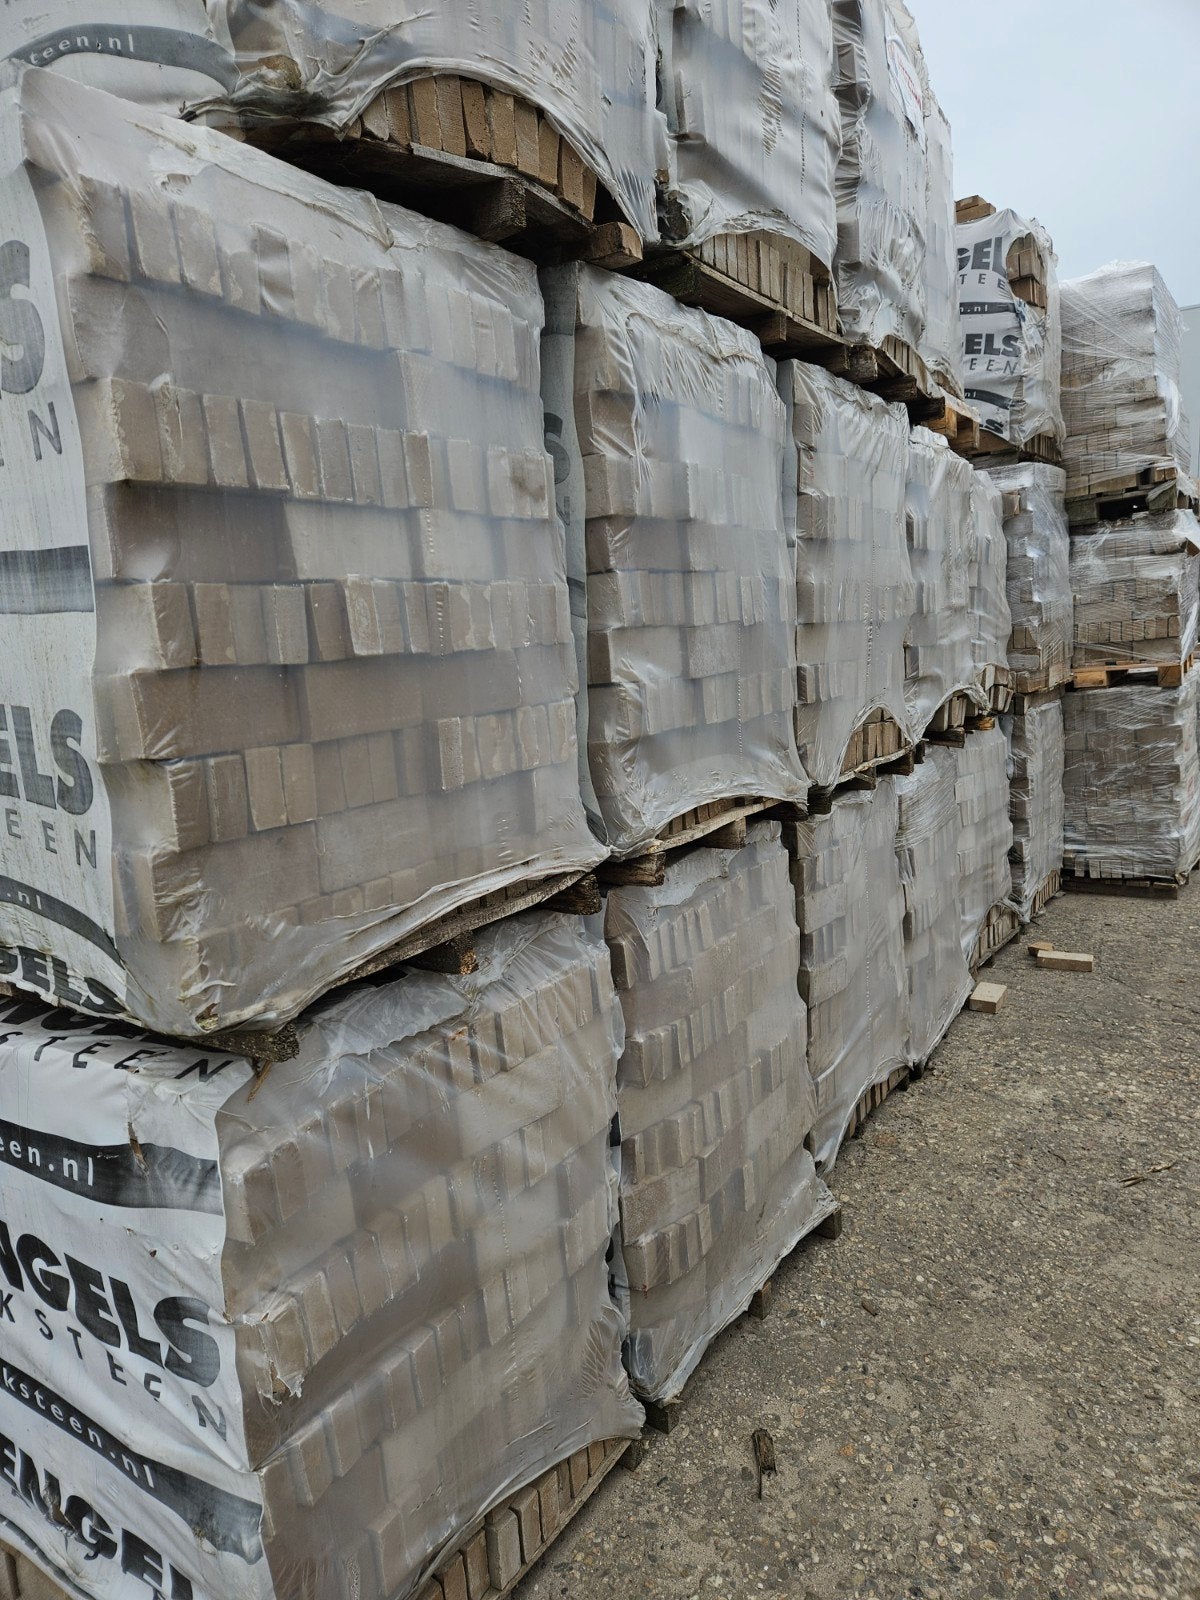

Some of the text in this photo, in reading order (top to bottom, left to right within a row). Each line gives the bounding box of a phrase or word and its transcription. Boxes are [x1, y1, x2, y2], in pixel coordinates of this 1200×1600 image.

[969, 358, 1018, 375] EEN
[5, 807, 97, 869] EEN
[3, 1366, 155, 1489] ksteen.nl
